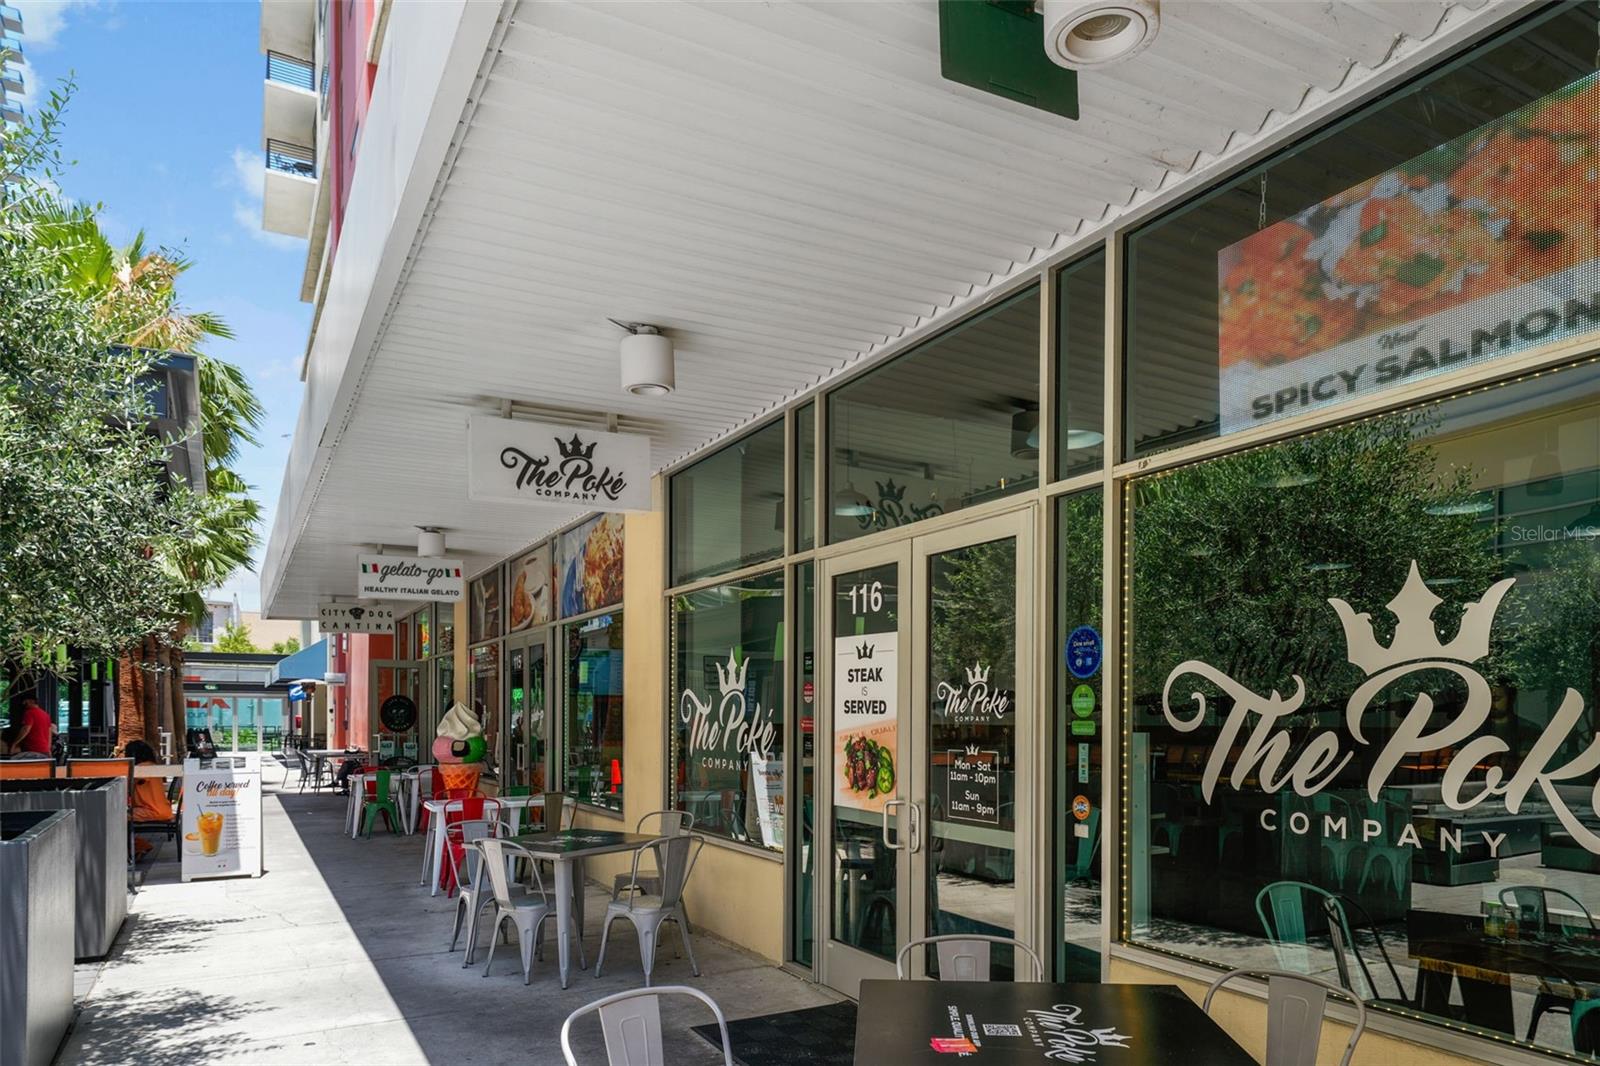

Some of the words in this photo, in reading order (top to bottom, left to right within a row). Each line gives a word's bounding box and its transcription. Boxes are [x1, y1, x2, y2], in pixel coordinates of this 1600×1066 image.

[1251, 364, 1366, 421] SPICY
[1375, 291, 1600, 385] SALMON
[500, 447, 563, 490] The
[559, 457, 627, 501] Poké
[535, 488, 598, 501] COMPANY
[379, 562, 444, 585] gelato-go
[364, 586, 398, 594] HEALTHY
[400, 587, 429, 595] ITALIAN
[849, 581, 883, 615] 116
[321, 608, 347, 617] CITY
[368, 610, 393, 618] DOG
[321, 622, 393, 630] CANTINA
[847, 667, 883, 683] STEAK
[861, 686, 868, 696] IS
[844, 700, 887, 715] SERVED
[937, 681, 970, 717] The
[968, 681, 1009, 719] Poké
[680, 688, 721, 756] The
[719, 690, 777, 765] Poké
[702, 757, 749, 772] COMPANY
[1162, 659, 1353, 805] The
[1346, 660, 1600, 855] Pok
[954, 760, 971, 770] Mon
[977, 760, 991, 772] Sat
[950, 771, 968, 781] 11am
[974, 773, 996, 785] 10pm
[196, 780, 222, 793] Coffee
[224, 779, 250, 789] served
[965, 790, 980, 801] Sun
[952, 801, 970, 811] 11am
[976, 803, 995, 816] 9pm
[1260, 808, 1507, 858] COMPANY
